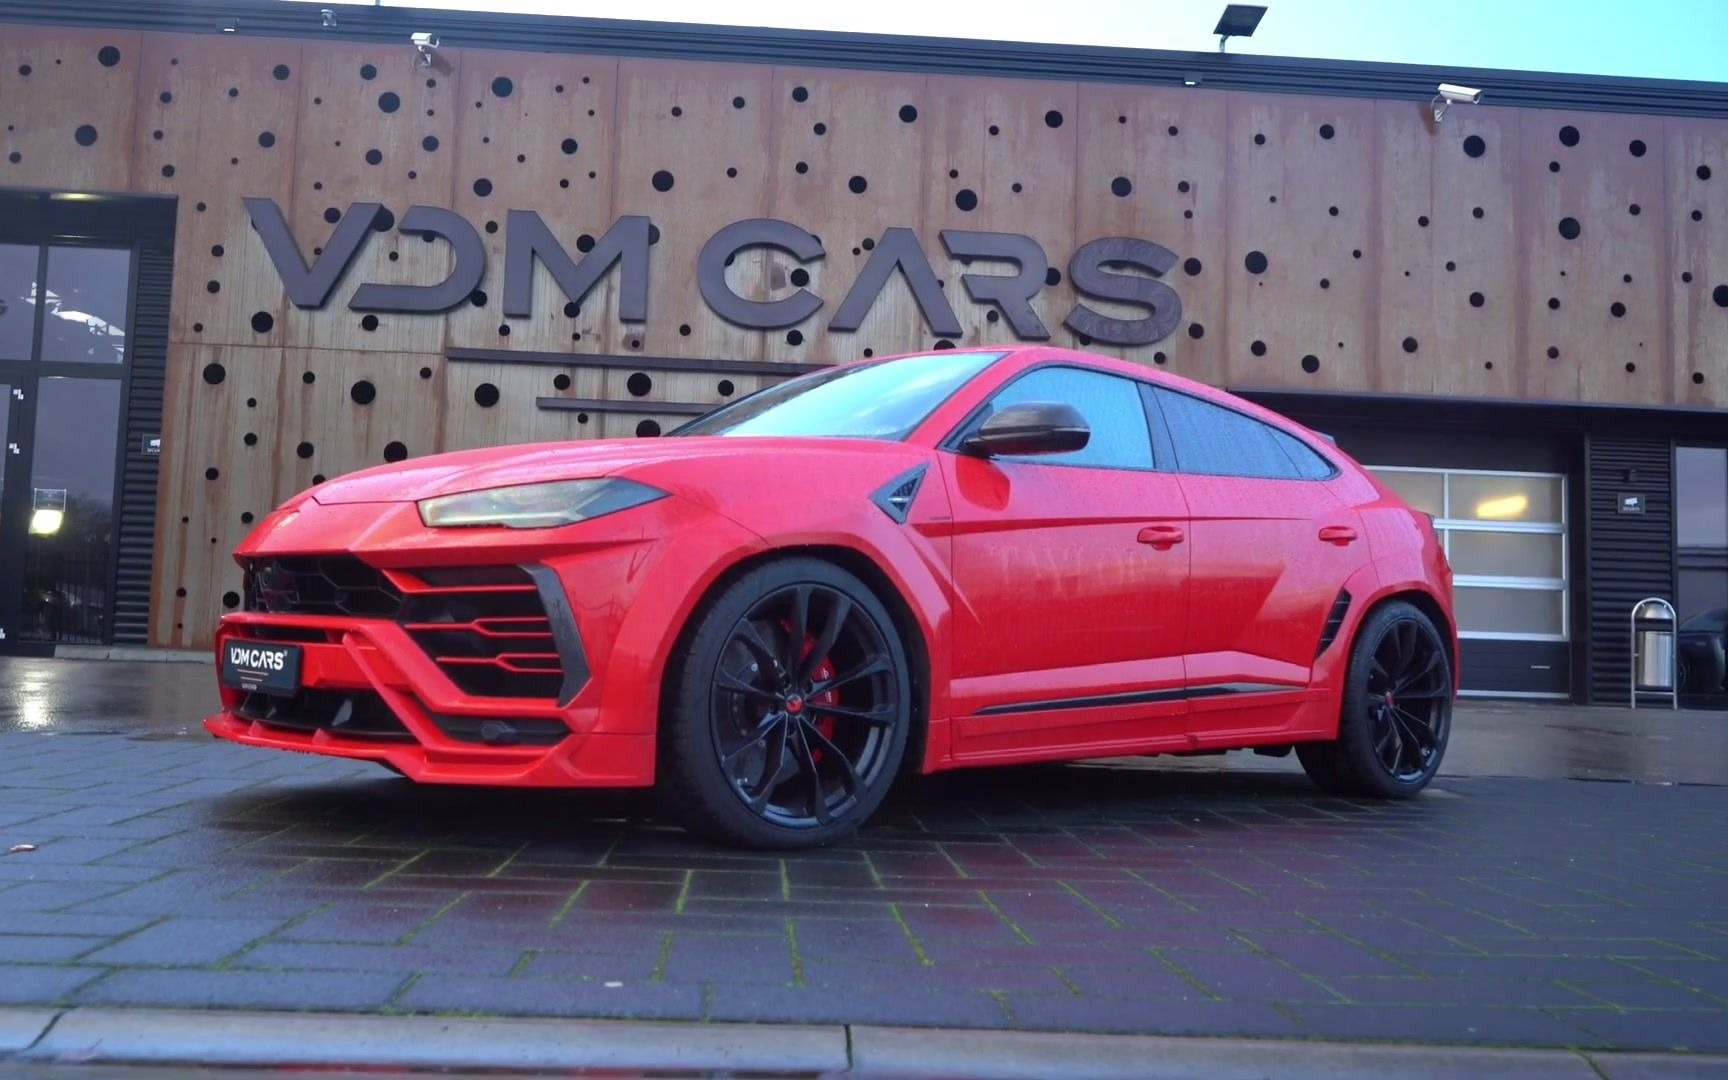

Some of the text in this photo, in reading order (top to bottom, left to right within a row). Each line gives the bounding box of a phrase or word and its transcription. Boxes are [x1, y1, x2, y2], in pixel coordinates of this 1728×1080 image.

[242, 197, 1182, 346] VDM CARS
[230, 647, 250, 666] VDM
